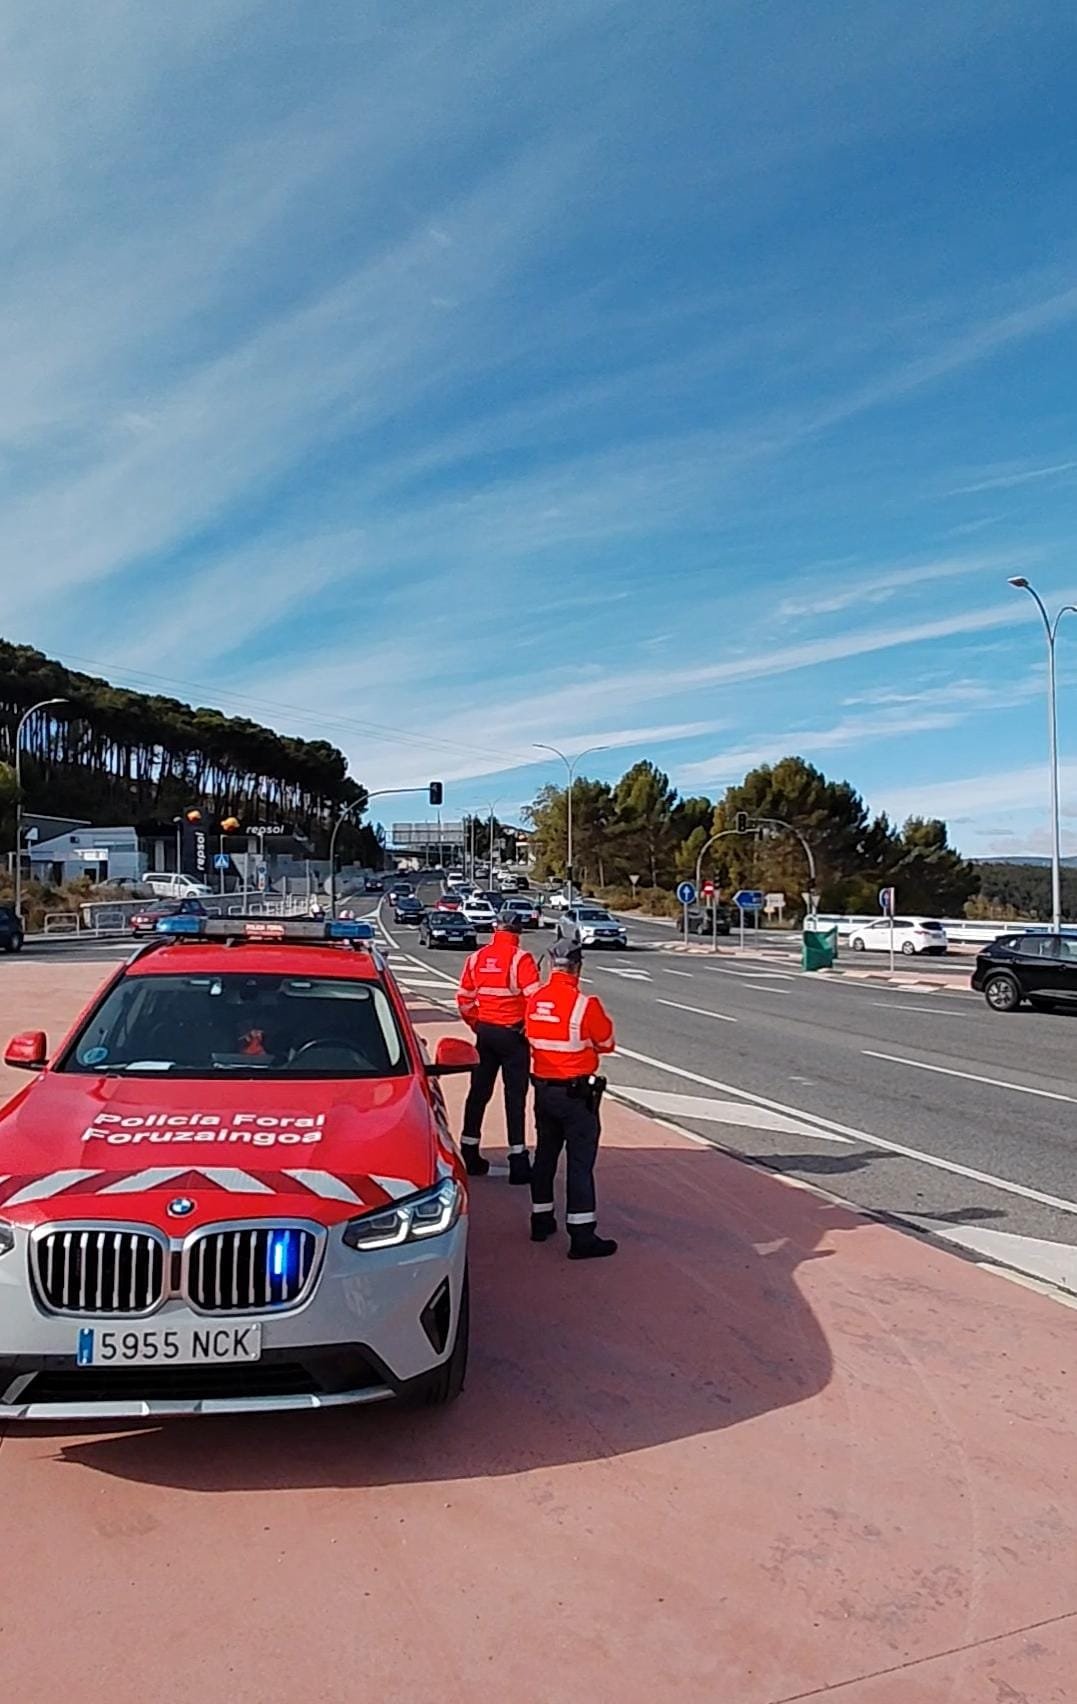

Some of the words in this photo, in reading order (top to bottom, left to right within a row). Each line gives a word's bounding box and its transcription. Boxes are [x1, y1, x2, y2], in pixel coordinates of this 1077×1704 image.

[246, 825, 285, 836] repsol
[195, 832, 206, 871] repsol
[94, 1113, 221, 1128] Policía
[233, 1113, 326, 1128] Foral
[81, 1127, 323, 1146] Foruzaingoa
[101, 1331, 180, 1360] 5955
[192, 1328, 251, 1358] NCK
